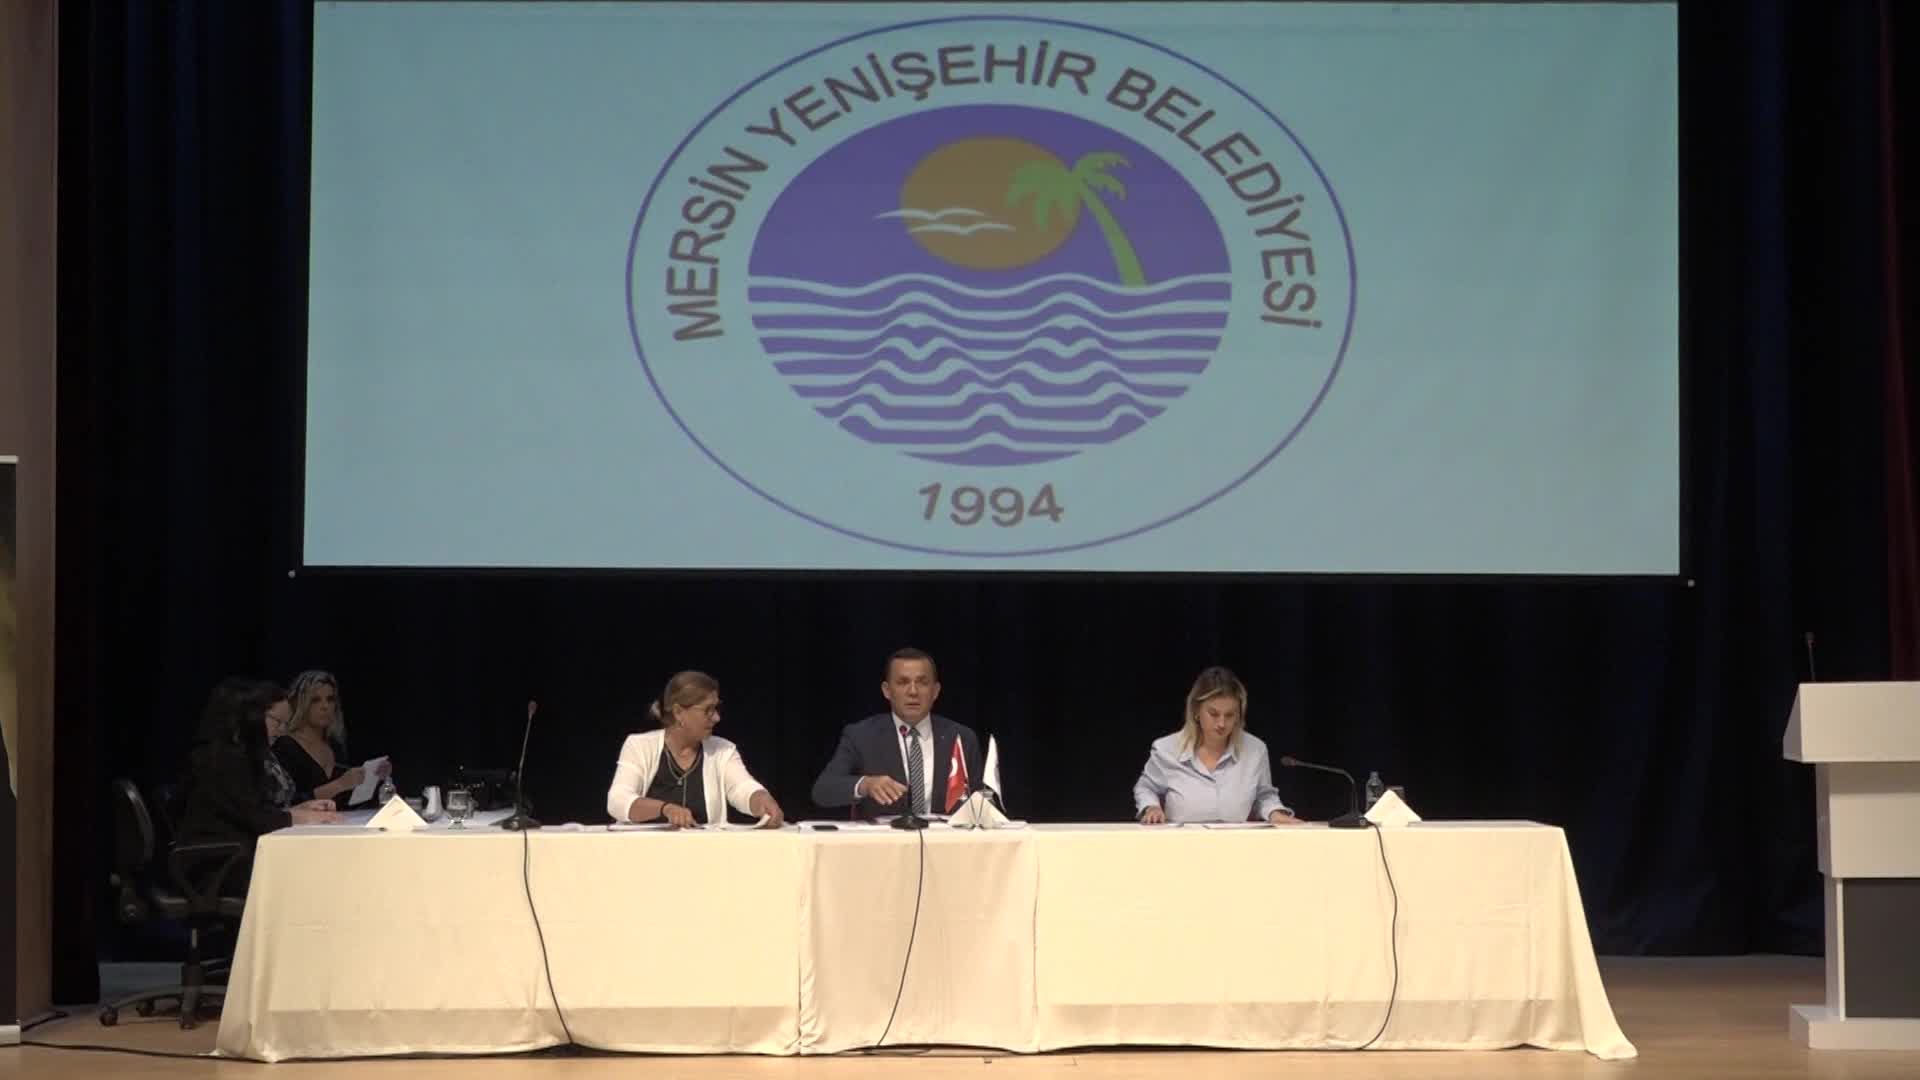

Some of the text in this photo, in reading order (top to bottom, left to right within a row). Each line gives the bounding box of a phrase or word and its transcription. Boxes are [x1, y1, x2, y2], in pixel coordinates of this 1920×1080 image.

[665, 39, 1323, 342] MERSİN YENİŞEHİR BELEDİYESİ
[918, 482, 1065, 528] 1994
